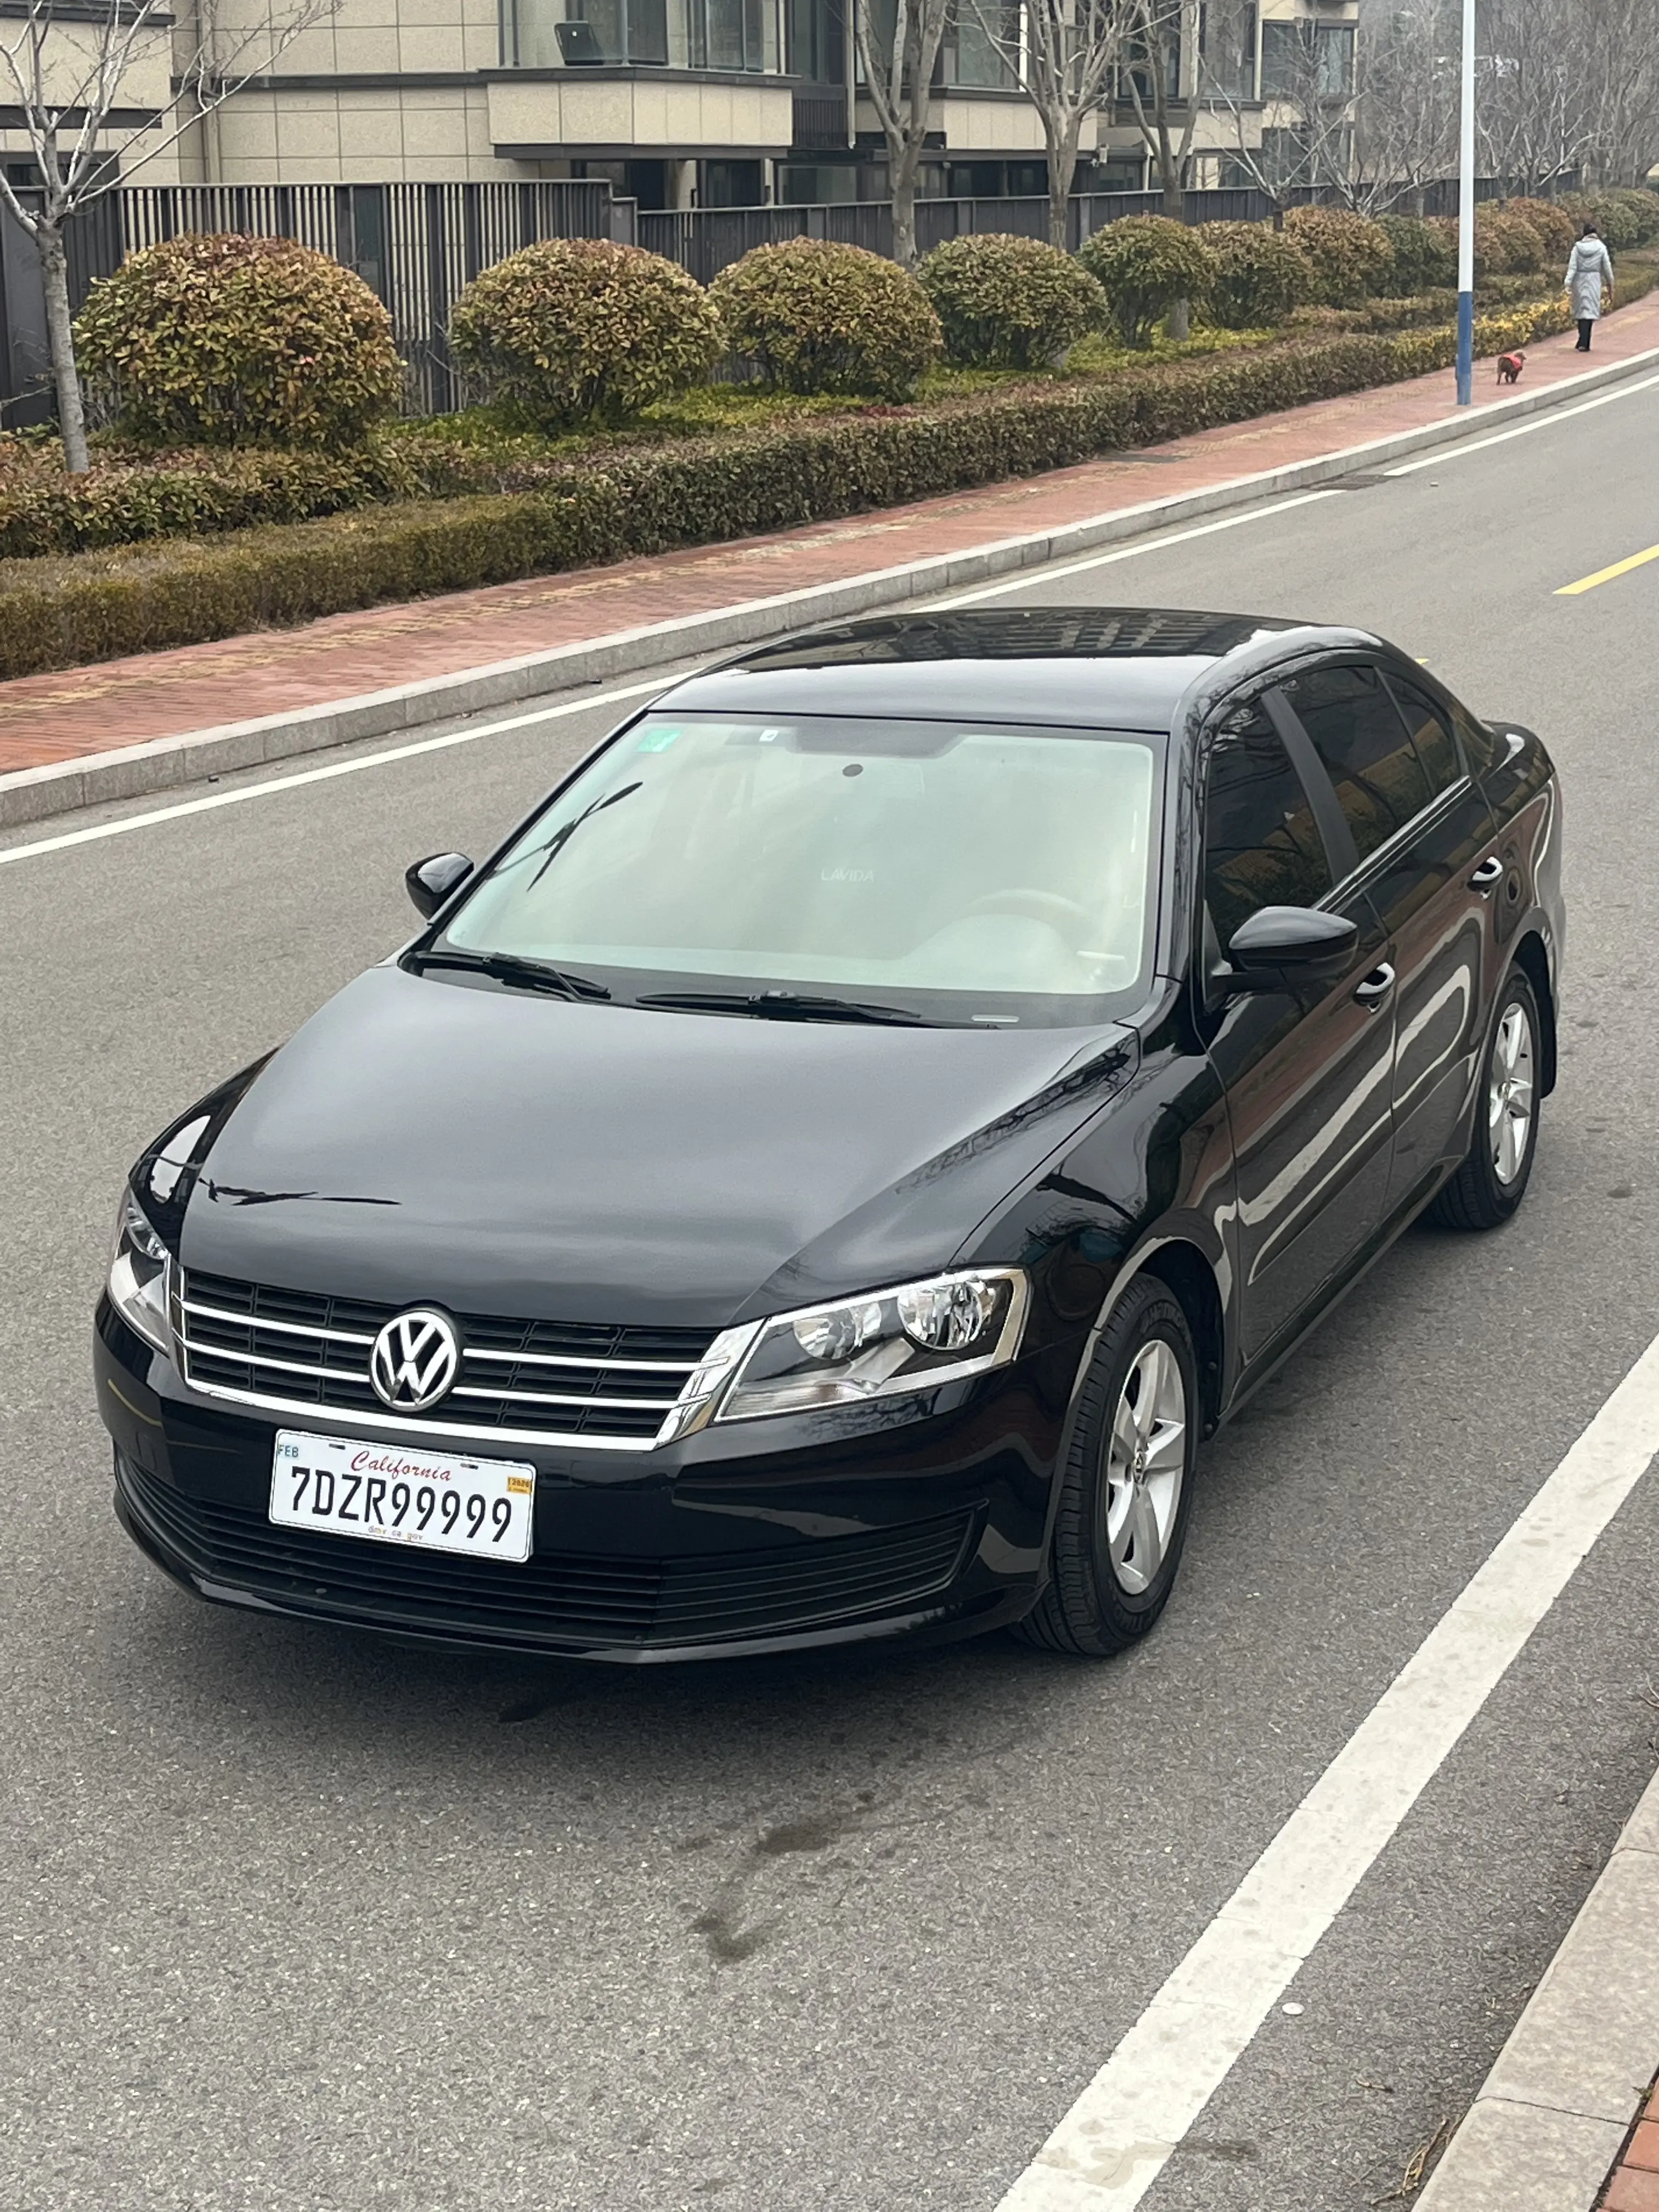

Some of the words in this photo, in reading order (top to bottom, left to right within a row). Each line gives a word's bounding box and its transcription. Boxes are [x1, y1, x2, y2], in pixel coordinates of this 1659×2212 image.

[821, 869, 874, 883] LAVIDA
[278, 1444, 298, 1458] FEB
[351, 1451, 451, 1481] California
[292, 1466, 511, 1542] 7DZR99999
